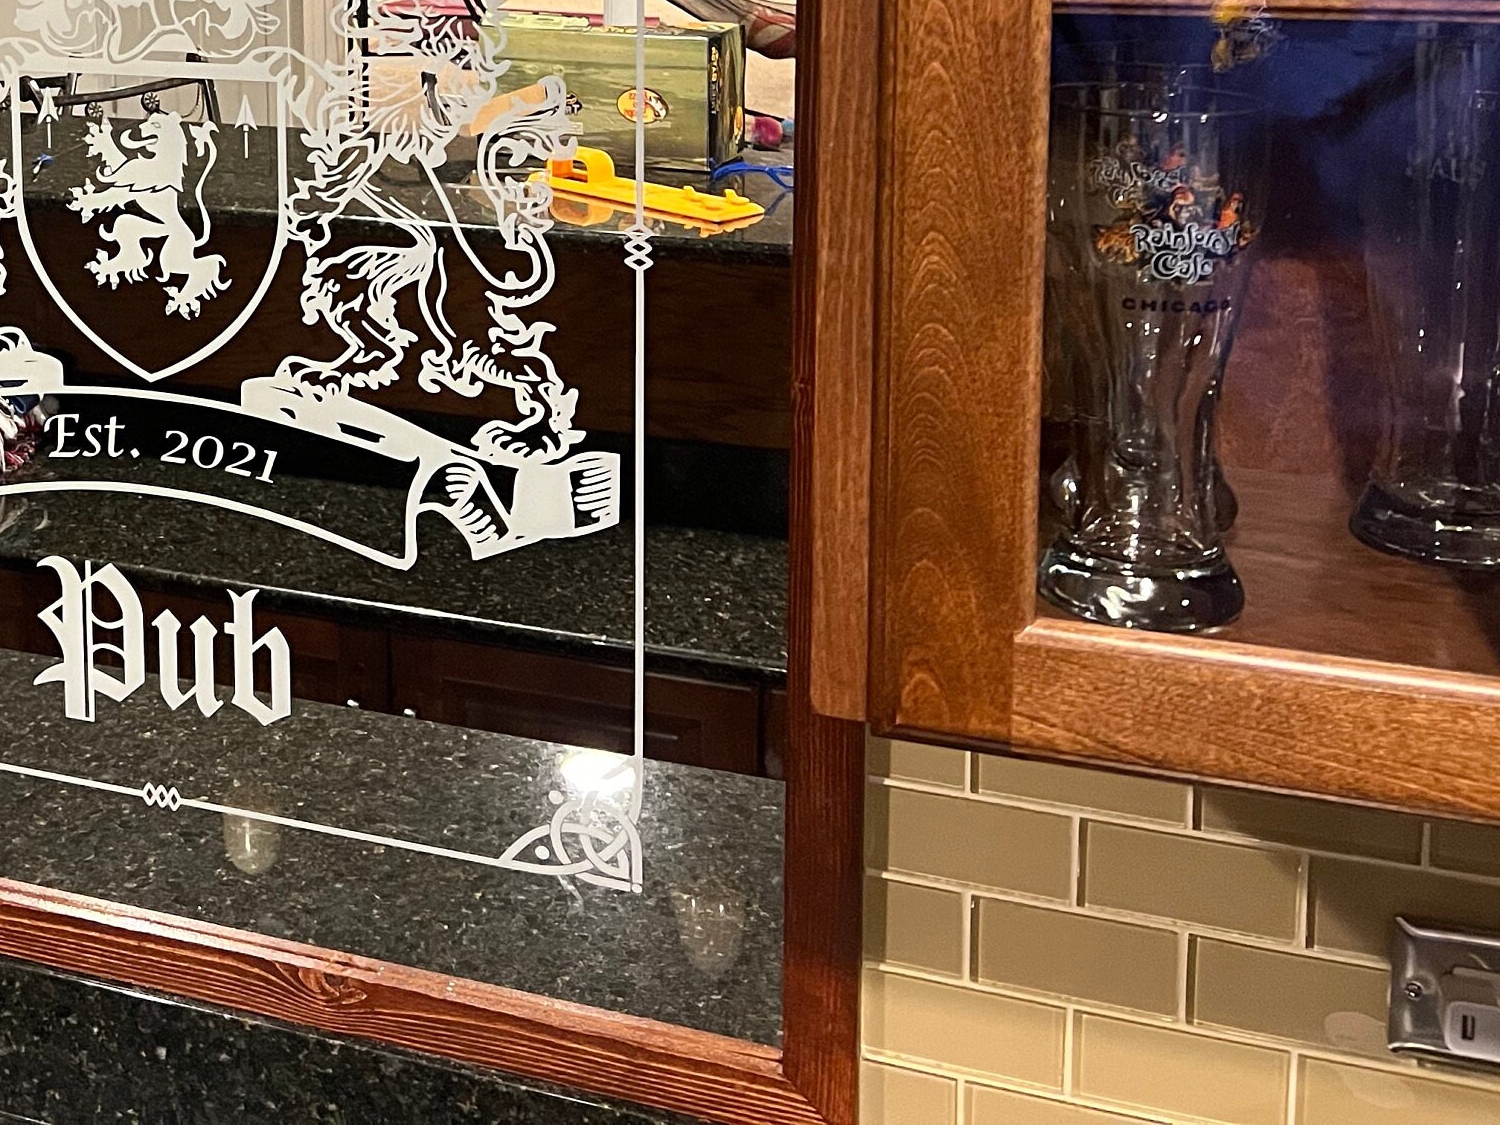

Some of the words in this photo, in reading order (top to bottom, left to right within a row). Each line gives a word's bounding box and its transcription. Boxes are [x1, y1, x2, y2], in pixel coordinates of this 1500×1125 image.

[1121, 297, 1231, 313] CHICAGO
[43, 413, 140, 459] Est.
[160, 429, 278, 484] 2021
[32, 555, 292, 726] Pub
